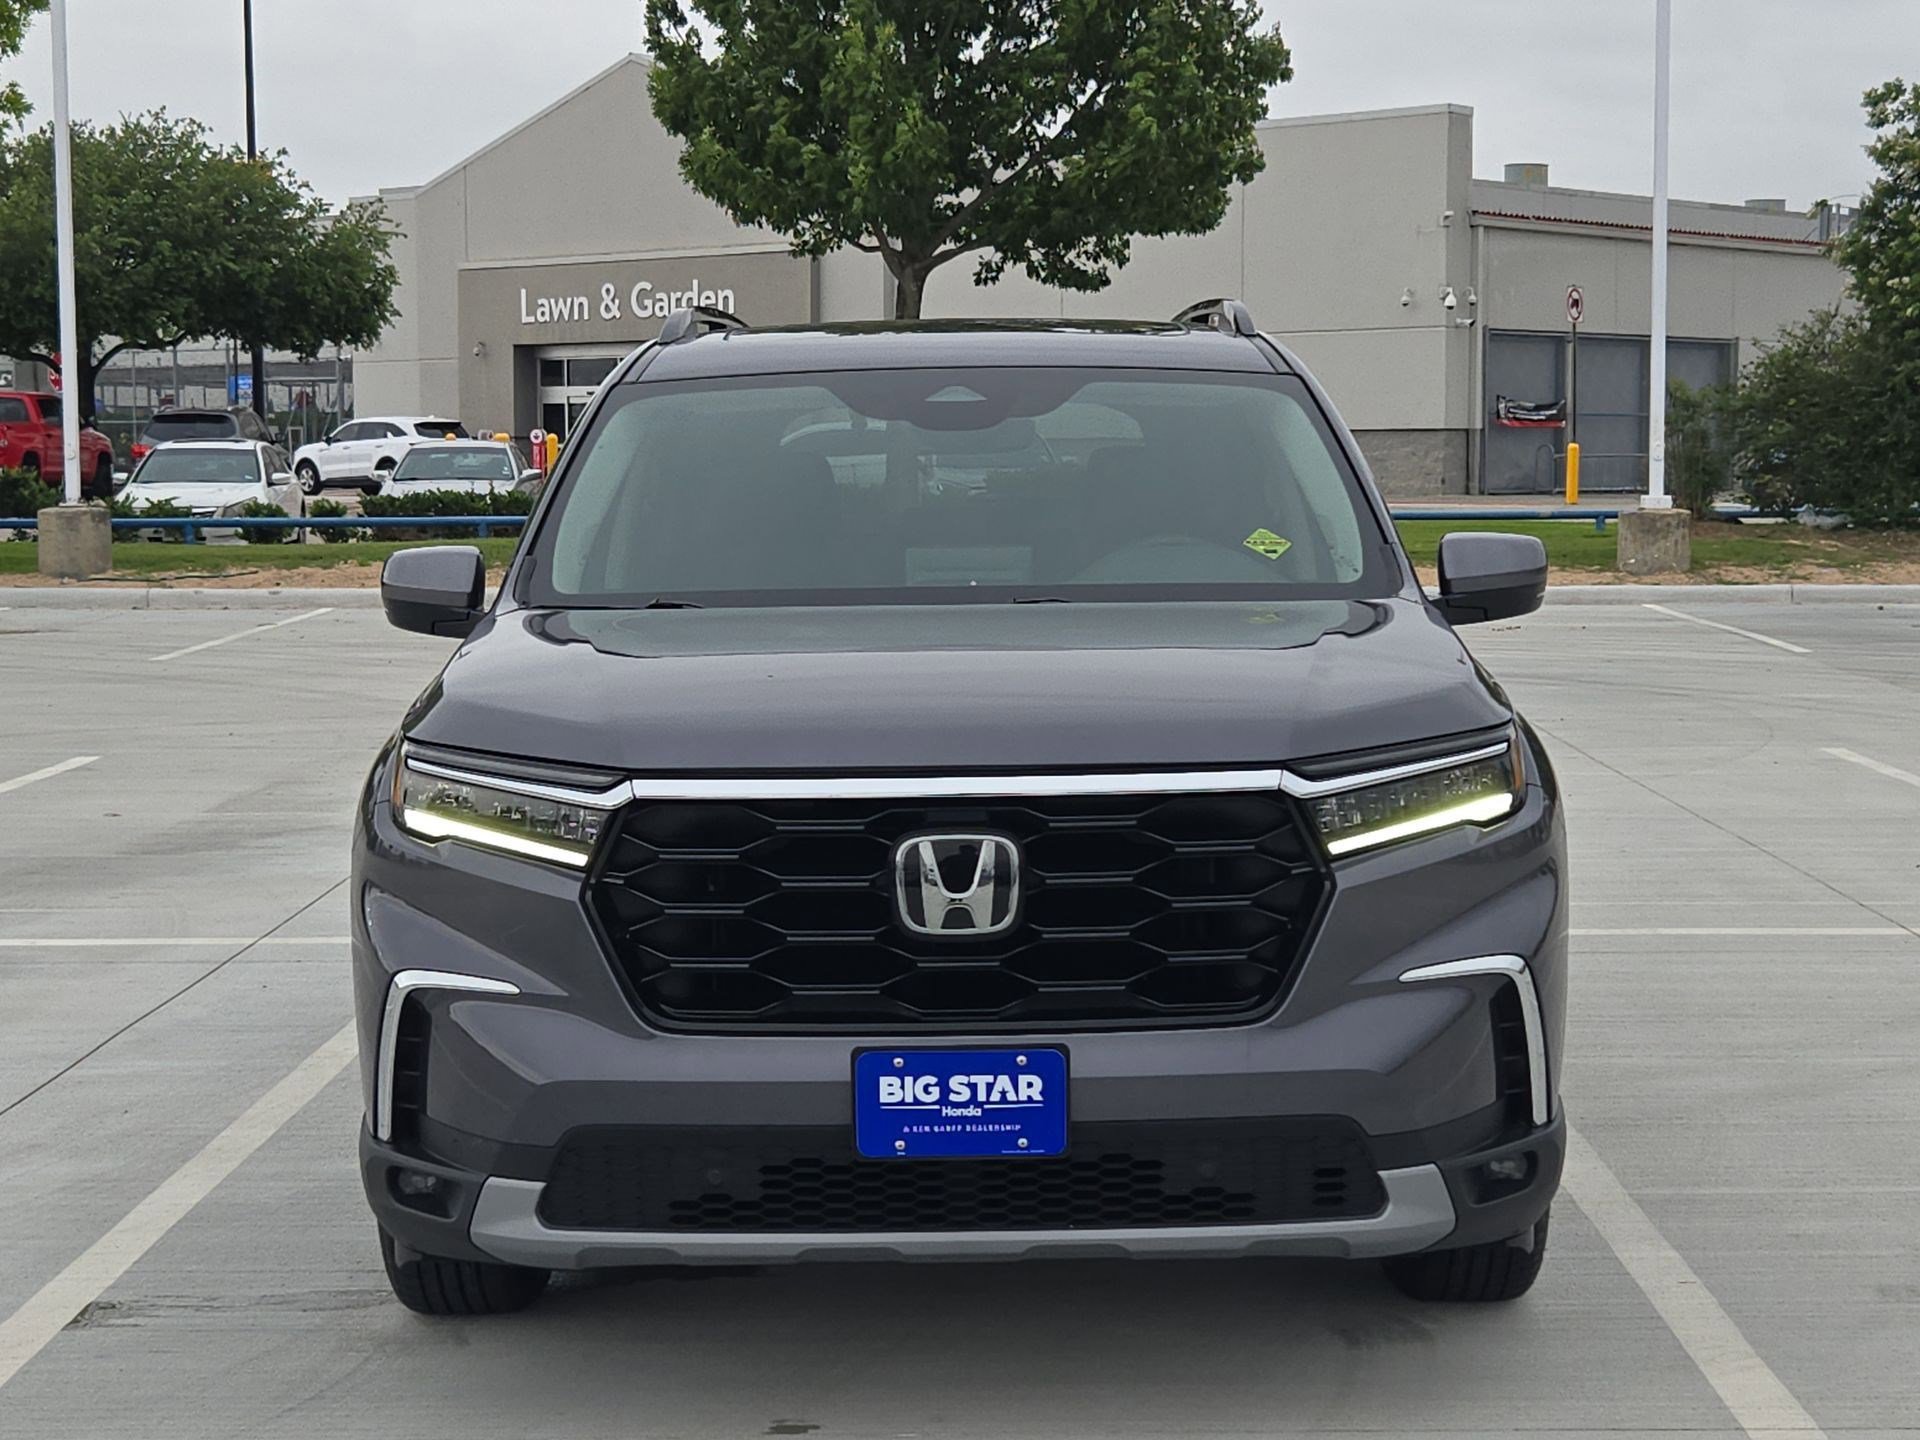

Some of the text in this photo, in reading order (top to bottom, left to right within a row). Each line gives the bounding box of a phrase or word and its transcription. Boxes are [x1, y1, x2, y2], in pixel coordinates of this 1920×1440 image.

[520, 279, 735, 323] Lawn & Garden
[879, 1074, 1044, 1103] BIG STAR
[942, 1105, 982, 1117] Honda
